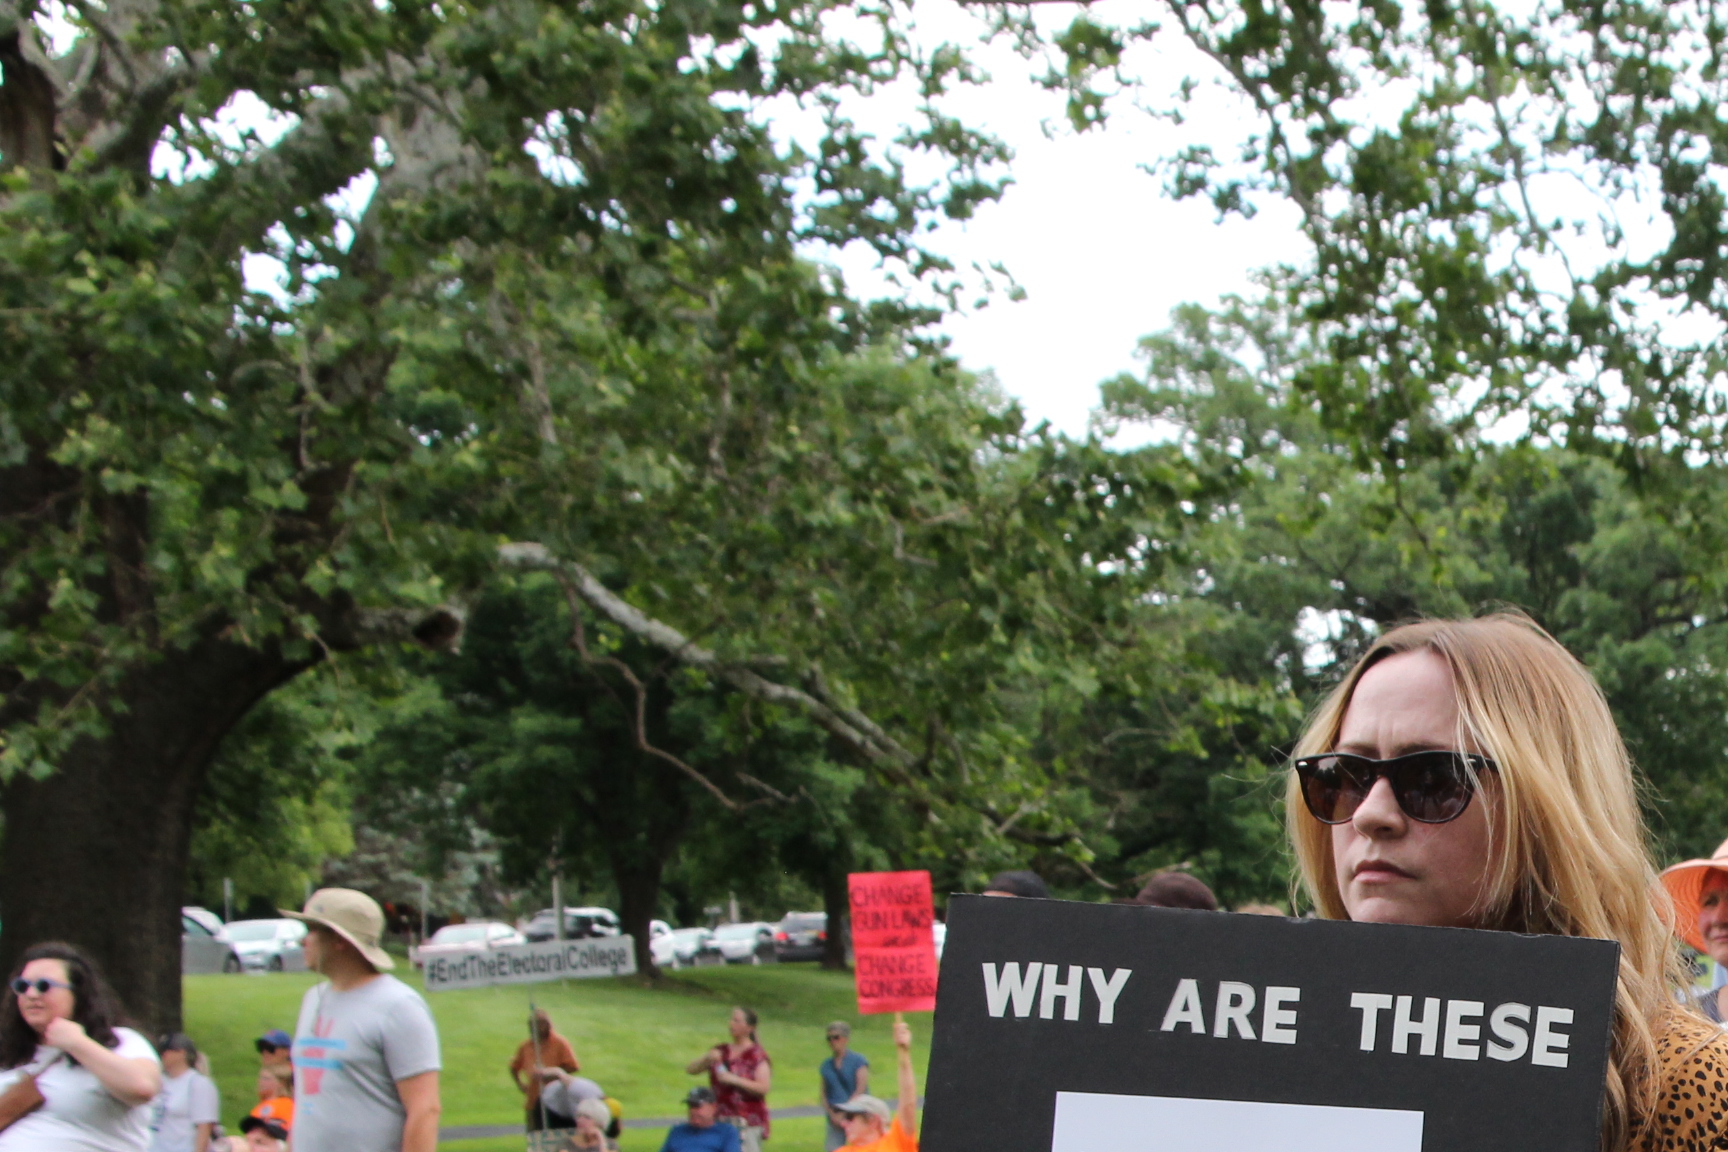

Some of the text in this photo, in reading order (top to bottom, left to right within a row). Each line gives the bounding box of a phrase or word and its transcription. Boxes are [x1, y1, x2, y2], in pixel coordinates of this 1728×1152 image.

[851, 884, 924, 907] CHANGE
[428, 946, 627, 983] #EndTheElectoralCollege
[858, 953, 928, 976] CHANGE
[859, 978, 936, 998] CONGRESS
[982, 962, 1574, 1067] WHY ARE THESE
